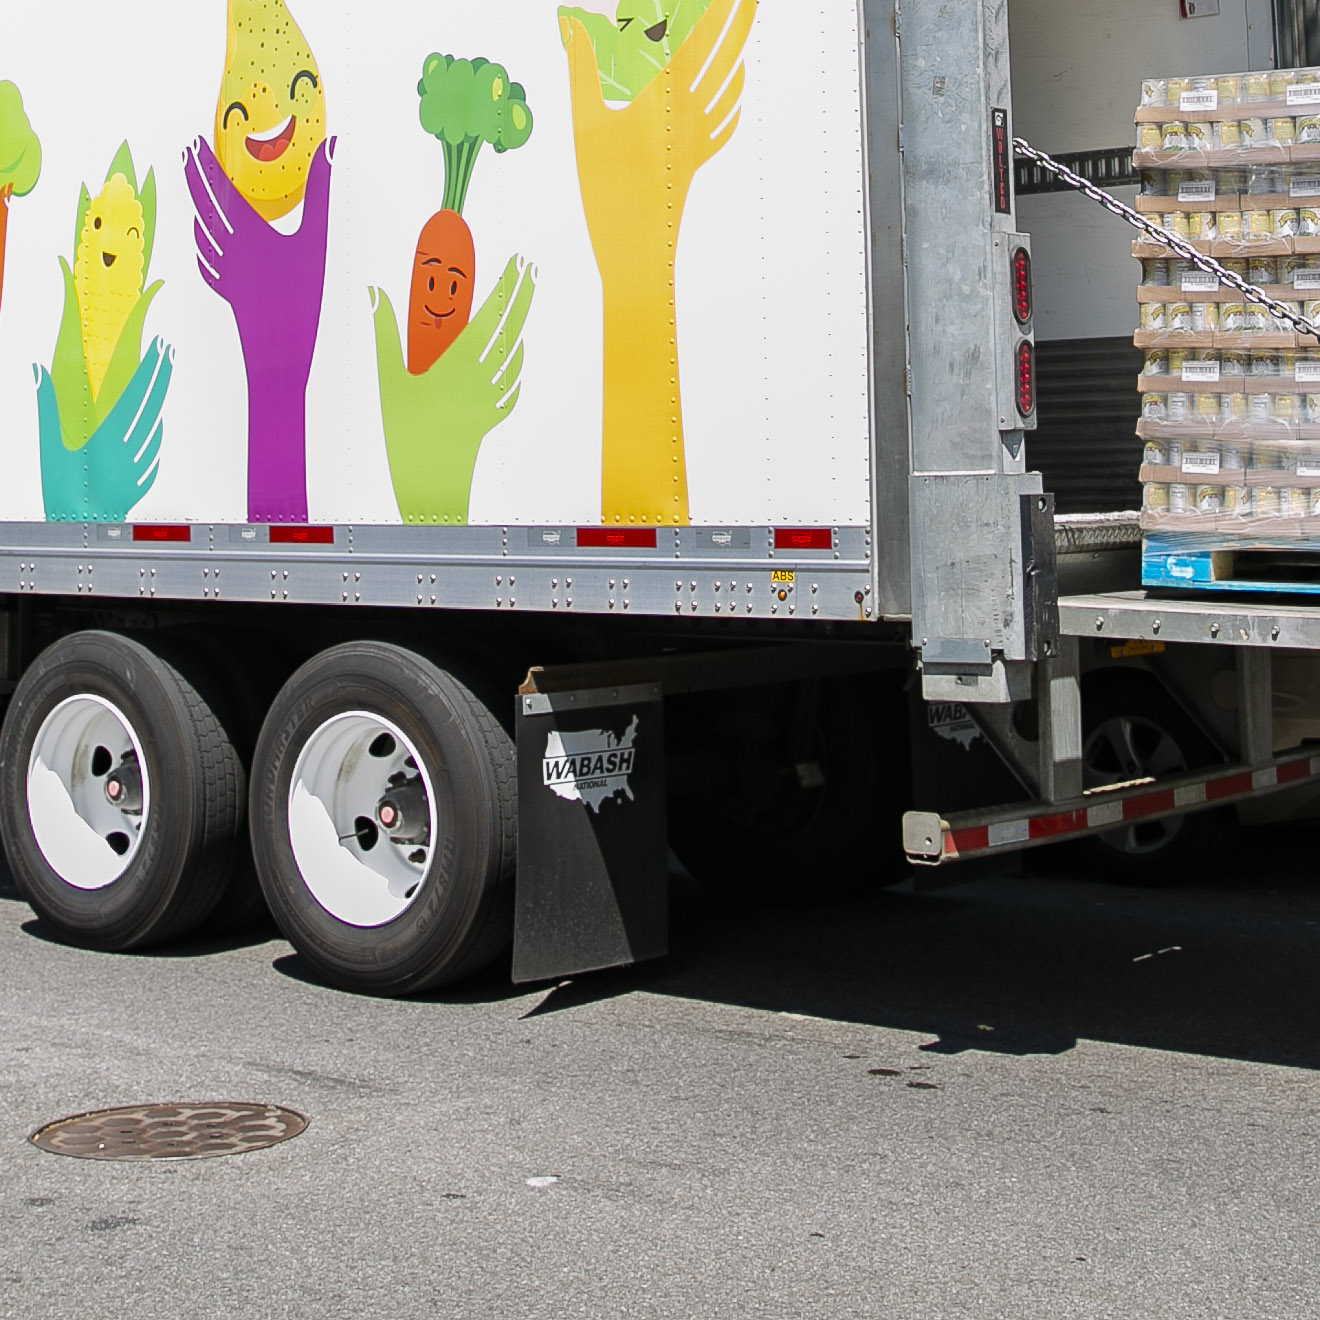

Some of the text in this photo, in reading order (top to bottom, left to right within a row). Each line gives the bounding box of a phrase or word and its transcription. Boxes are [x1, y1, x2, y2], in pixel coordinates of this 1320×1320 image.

[995, 127, 1006, 210] WALTCO
[545, 750, 633, 782] WABASH
[573, 780, 608, 792] NATIONAL
